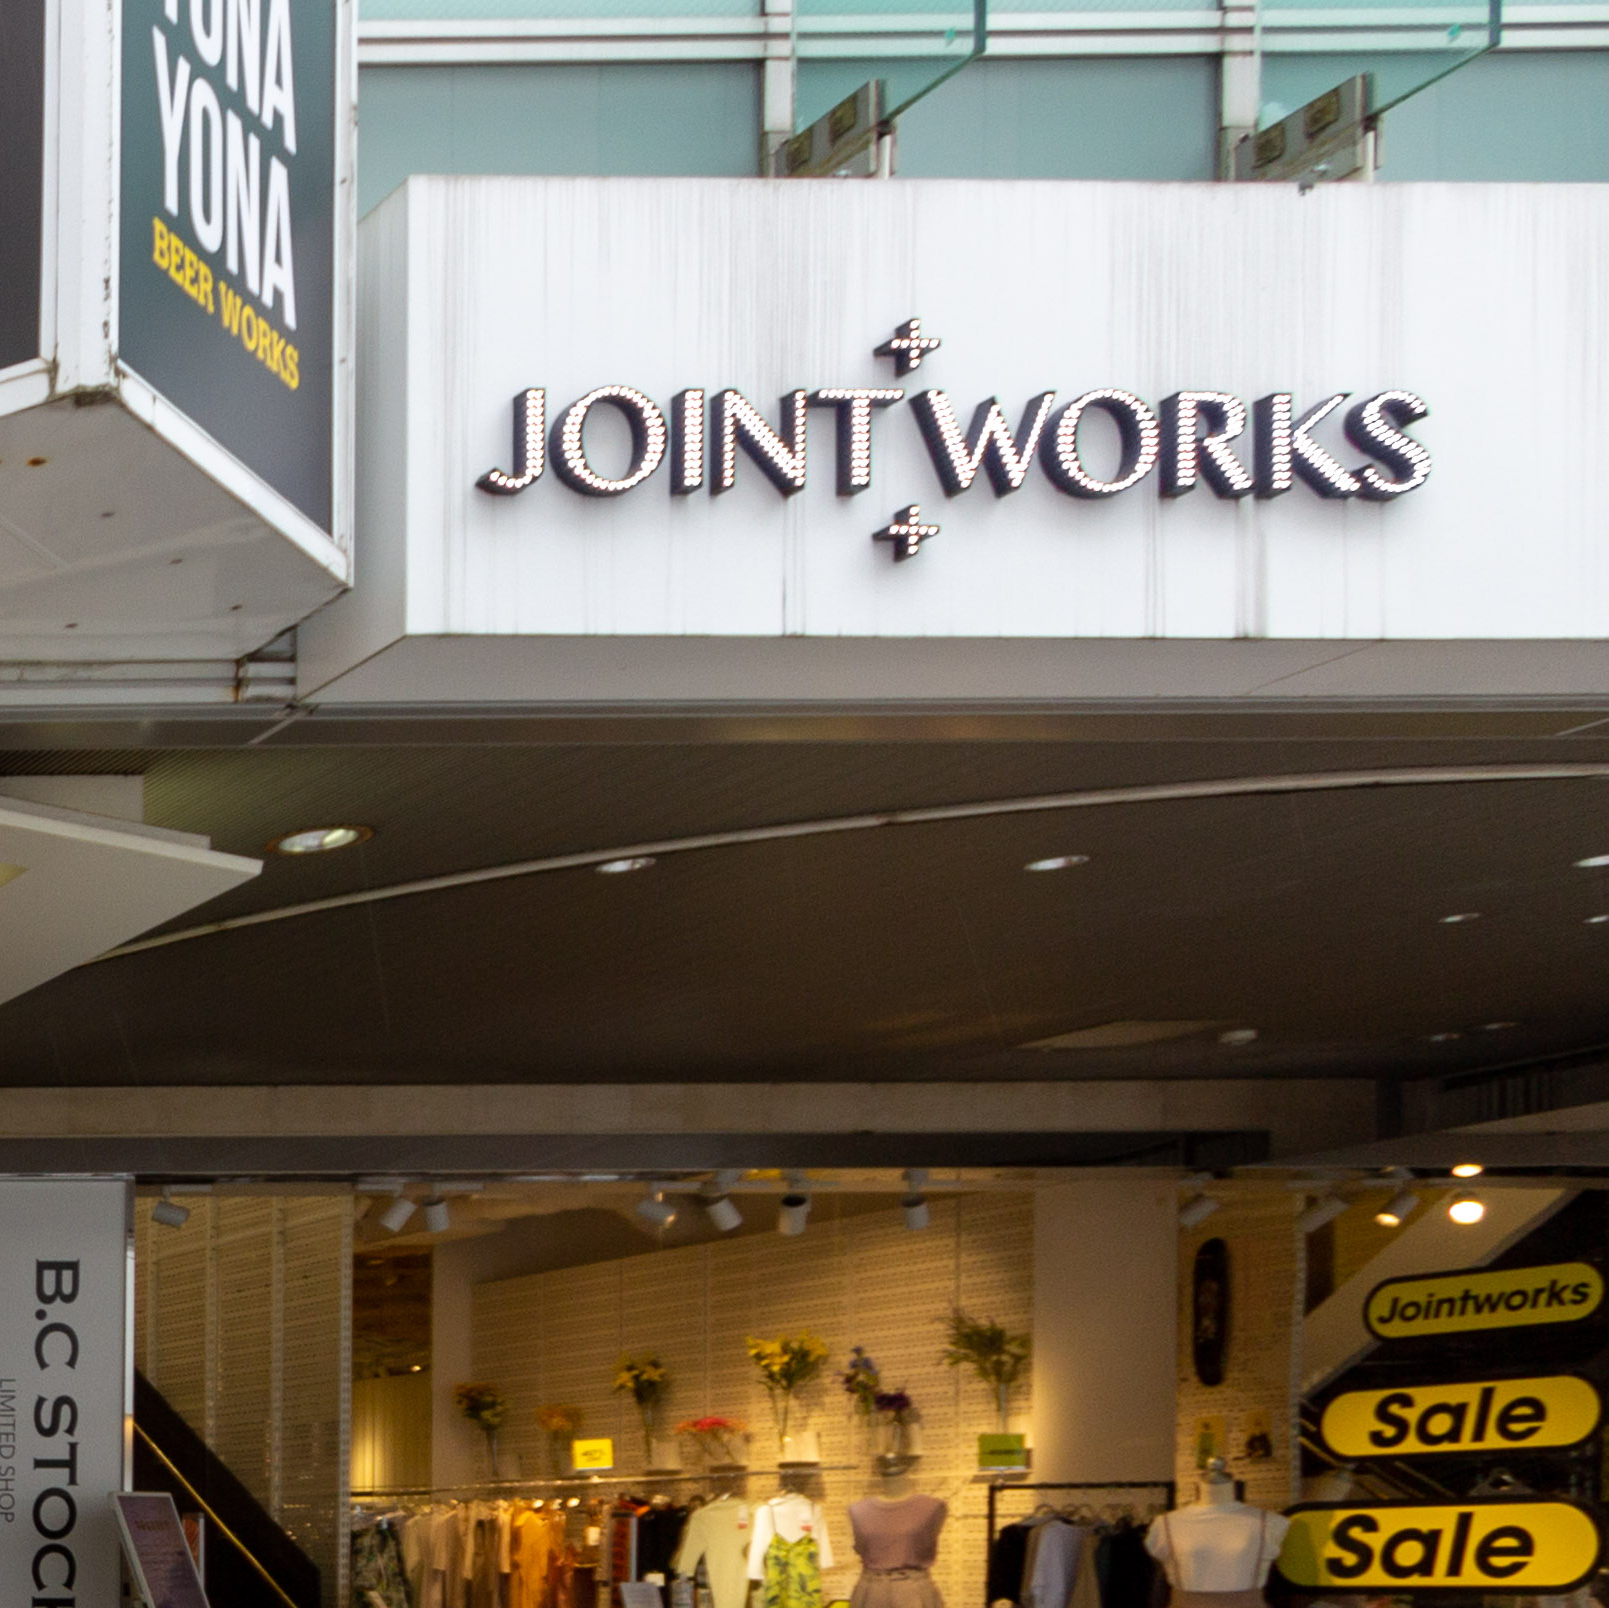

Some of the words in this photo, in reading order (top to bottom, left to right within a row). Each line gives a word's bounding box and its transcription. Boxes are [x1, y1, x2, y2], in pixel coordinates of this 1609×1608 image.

[152, 24, 298, 331] YONA
[152, 217, 214, 320] BEER
[218, 281, 300, 391] WORKS
[33, 1258, 81, 1371] B.C
[1375, 1278, 1591, 1325] Jointworks
[1368, 1386, 1547, 1449] Sale
[1325, 1511, 1537, 1580] Sale
